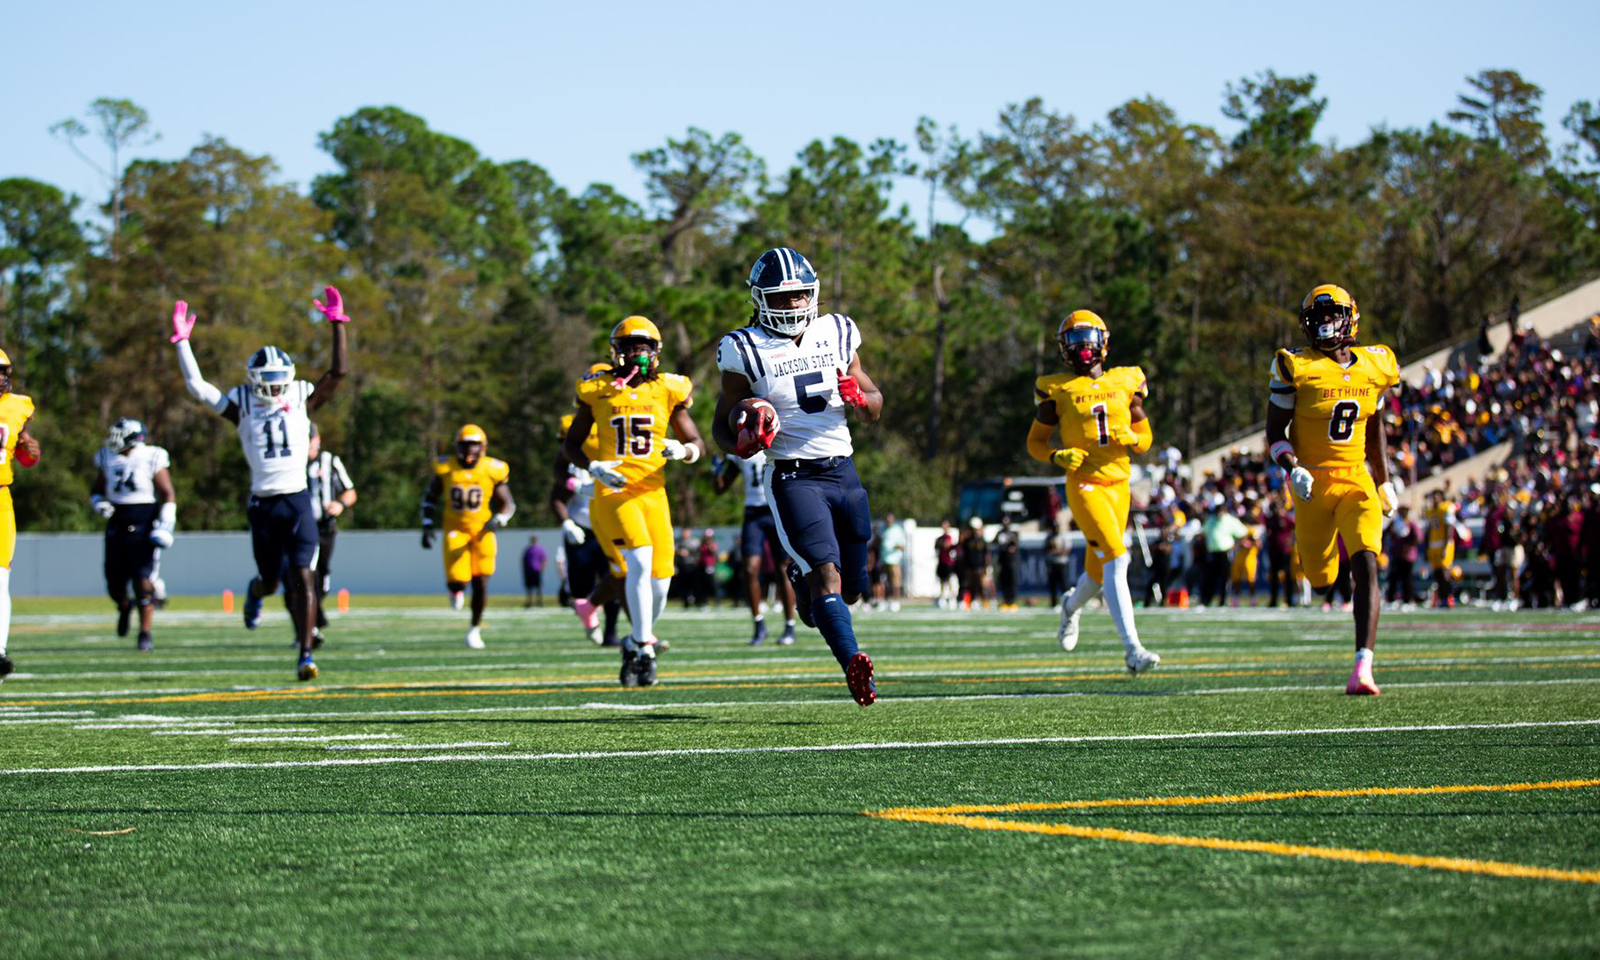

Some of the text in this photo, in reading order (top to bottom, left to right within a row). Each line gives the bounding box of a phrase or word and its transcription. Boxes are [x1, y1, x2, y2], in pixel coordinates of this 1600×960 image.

[773, 353, 835, 378] JACKSON STATE
[793, 371, 834, 415] 5
[1075, 391, 1118, 404] BETHUNE
[1322, 388, 1370, 399] BETHUNE
[262, 418, 292, 459] 11
[610, 414, 655, 457] 15
[1090, 401, 1109, 446] 1
[1328, 399, 1360, 443] 8
[450, 485, 483, 513] 90
